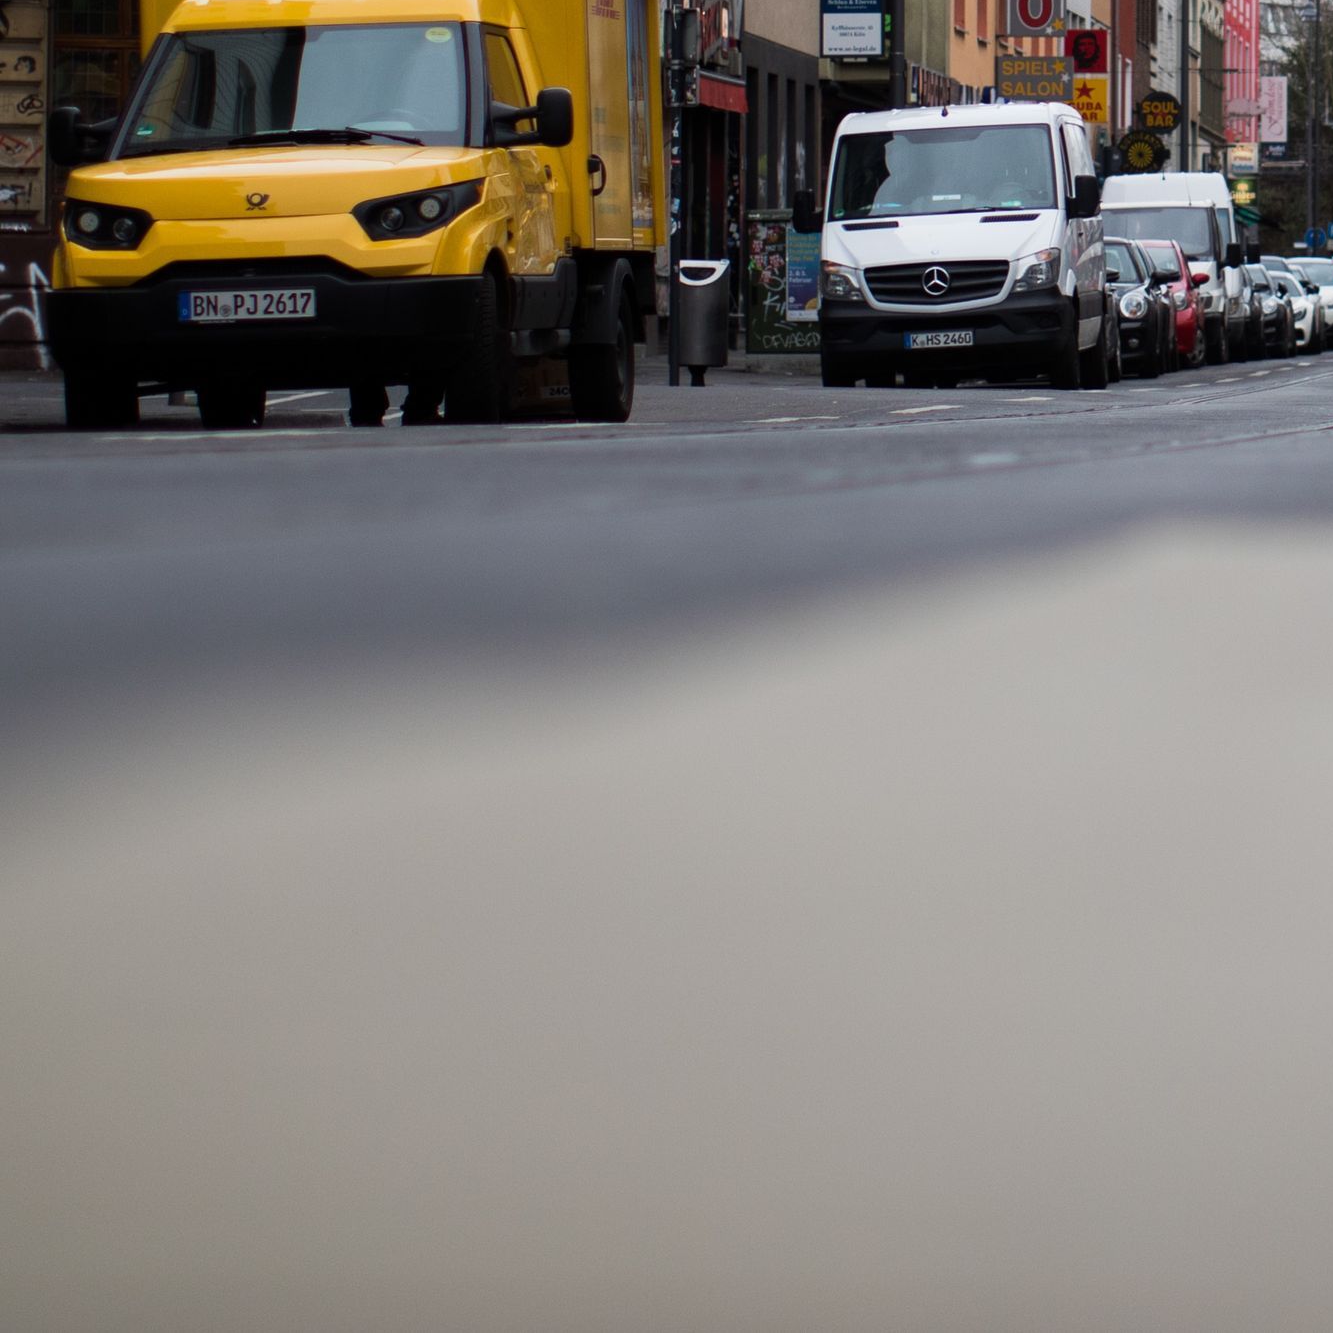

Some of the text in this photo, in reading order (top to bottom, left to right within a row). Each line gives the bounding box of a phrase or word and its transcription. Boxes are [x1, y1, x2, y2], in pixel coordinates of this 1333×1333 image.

[1002, 61, 1053, 75] SPIEL
[1002, 82, 1064, 96] SALON
[1142, 101, 1179, 113] SOUL
[1146, 116, 1174, 127] BAR
[193, 293, 312, 316] BN PJ 2617
[912, 332, 972, 347] K HS 2460
